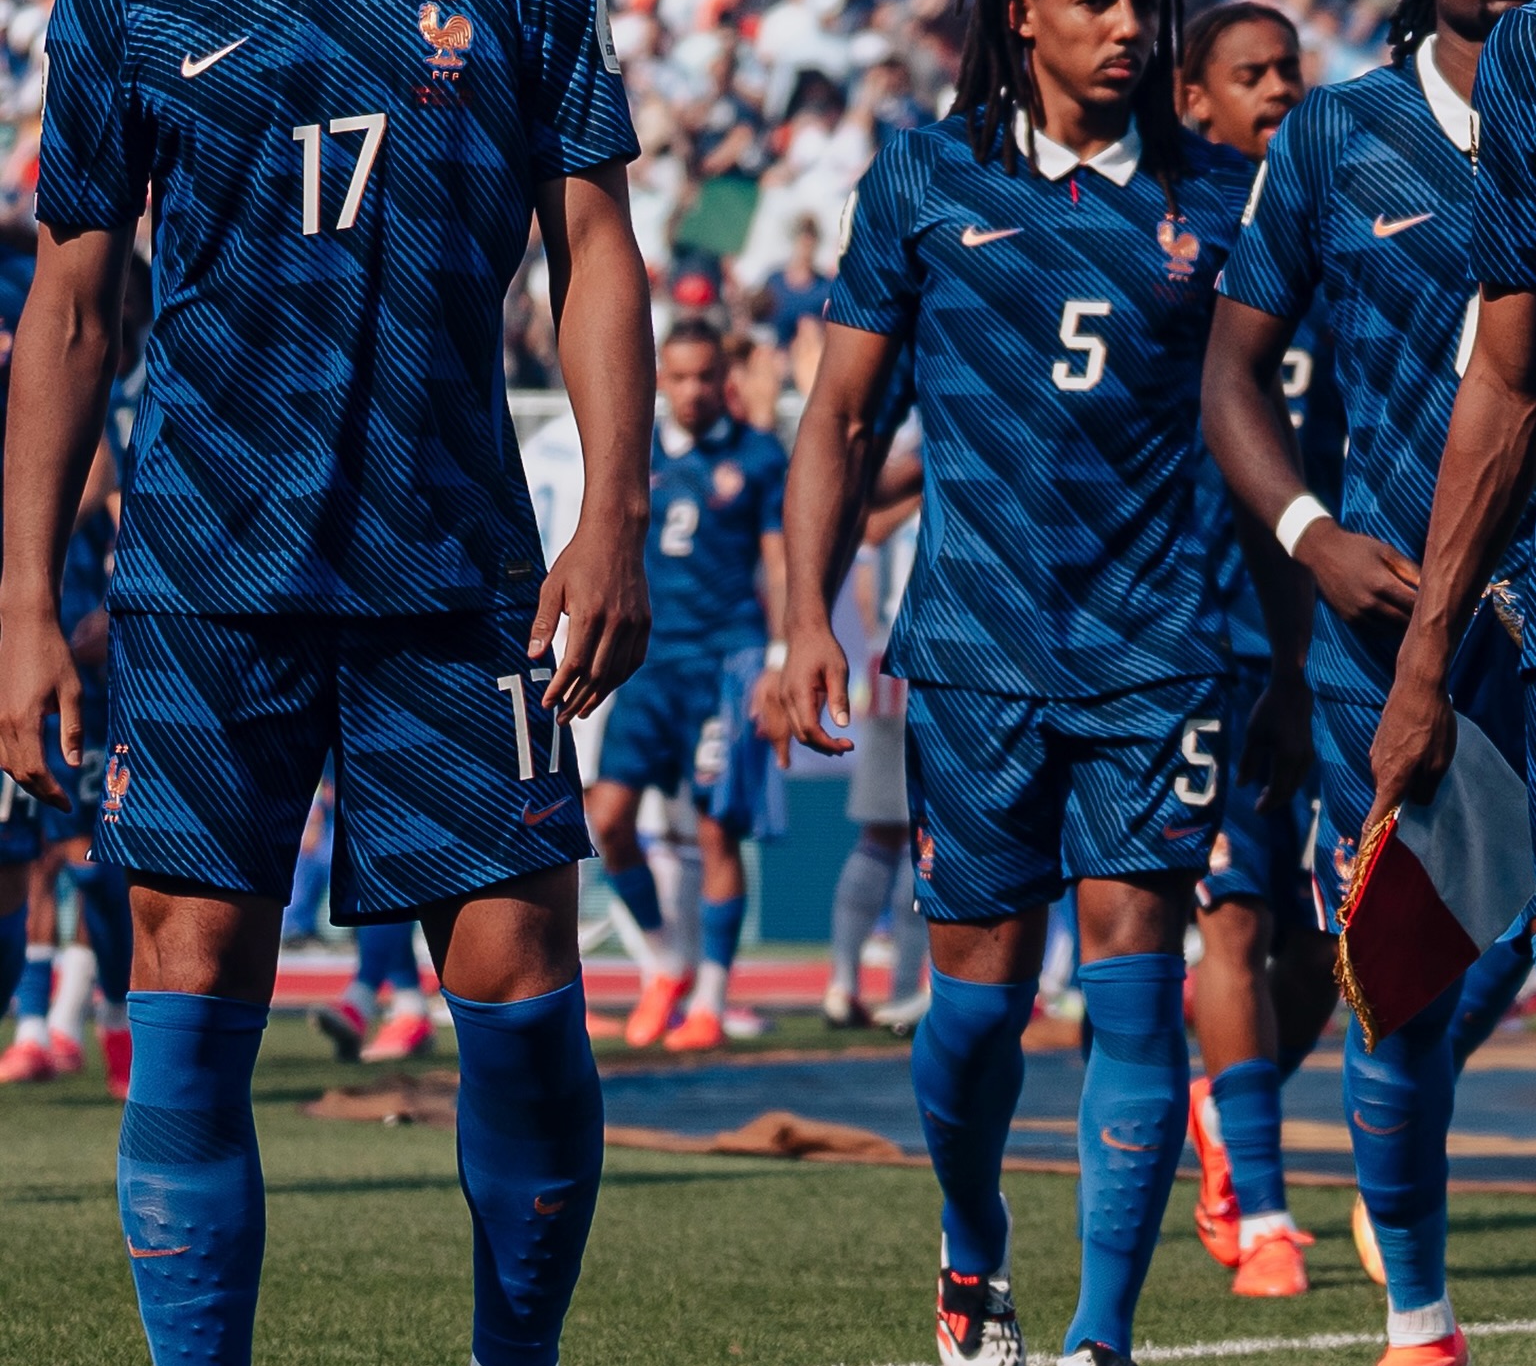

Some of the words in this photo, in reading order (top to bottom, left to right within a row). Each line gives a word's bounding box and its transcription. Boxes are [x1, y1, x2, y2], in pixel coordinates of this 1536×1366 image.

[293, 112, 387, 235] 17
[1051, 300, 1112, 392] 5
[659, 499, 700, 558] 2
[1174, 719, 1221, 806] 5
